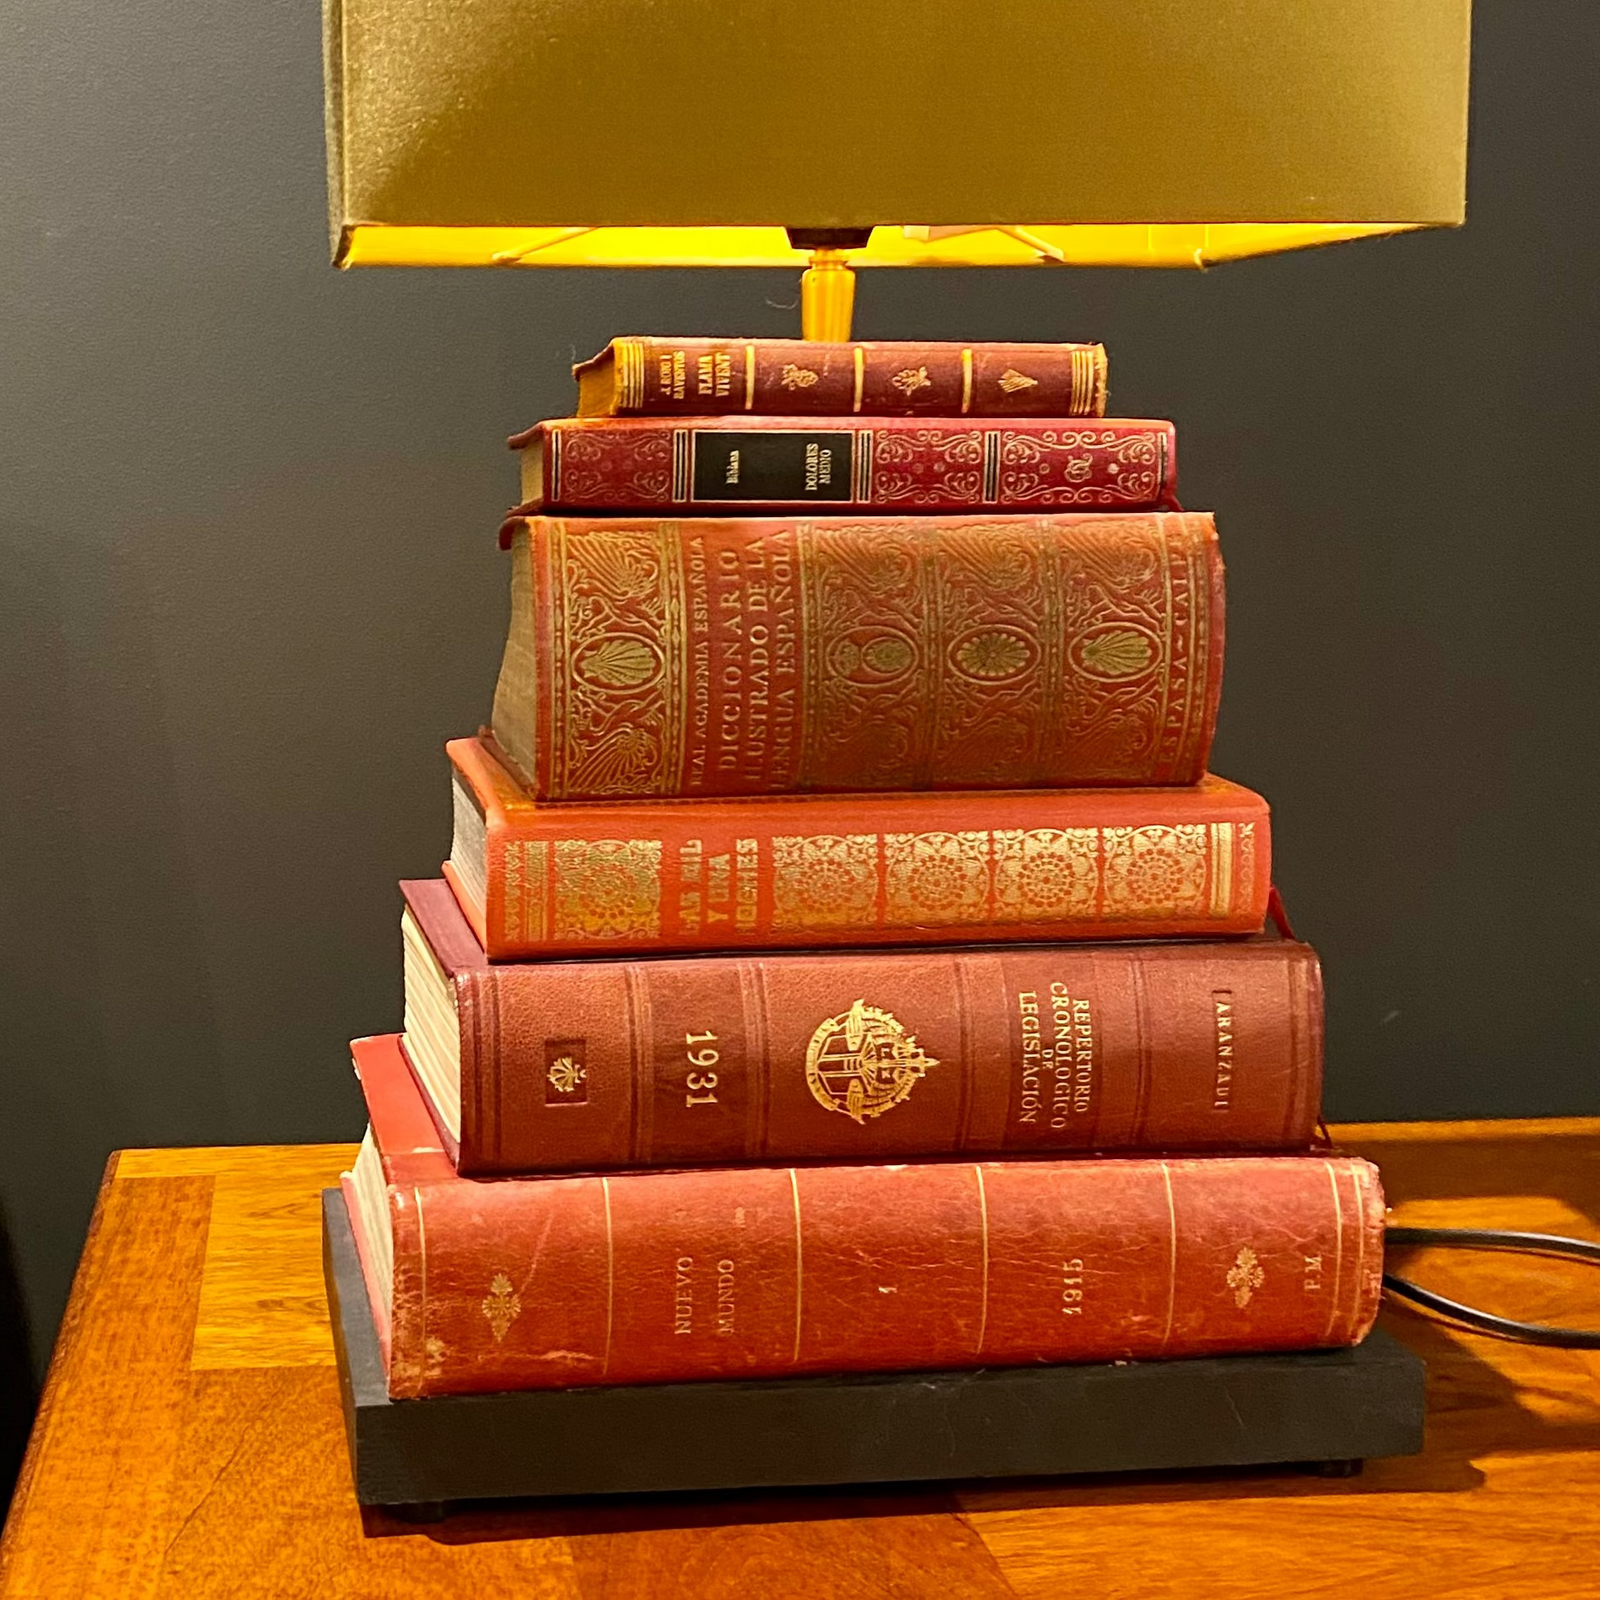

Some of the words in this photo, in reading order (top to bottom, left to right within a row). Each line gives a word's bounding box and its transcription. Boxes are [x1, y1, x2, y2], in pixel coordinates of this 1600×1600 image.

[699, 355, 712, 394] FLAMA
[716, 352, 730, 396] VIVENT
[726, 451, 739, 483] Bibiana
[806, 444, 818, 490] DOLORES
[819, 450, 831, 484] MEDIO
[689, 537, 708, 632] ESPAÑOLA
[745, 537, 765, 569] LA
[747, 580, 768, 611] DE
[770, 529, 795, 672] ESPAÑOLA
[695, 642, 709, 737] ACADEMIA
[720, 551, 742, 769] DICCIONARIO
[744, 625, 768, 780] ILUSTRADO
[690, 745, 706, 785] REAL
[771, 689, 795, 787] LENGUA
[681, 840, 702, 882] MIL
[708, 854, 730, 902] UNA
[736, 838, 758, 934] NOCHES
[679, 893, 701, 934] LAS
[708, 910, 728, 922] Y
[686, 1031, 719, 1107] 1931
[1019, 991, 1041, 1123] LEGISLACIÓN
[1042, 1049, 1054, 1069] DE
[1050, 982, 1072, 1128] CRONOLOGICO
[1074, 1000, 1092, 1112] REPERTORIO
[1215, 1003, 1232, 1106] ARANZADI
[675, 1257, 693, 1334] NUEVO
[718, 1259, 735, 1333] MUNDO
[1061, 1259, 1083, 1315] 1915
